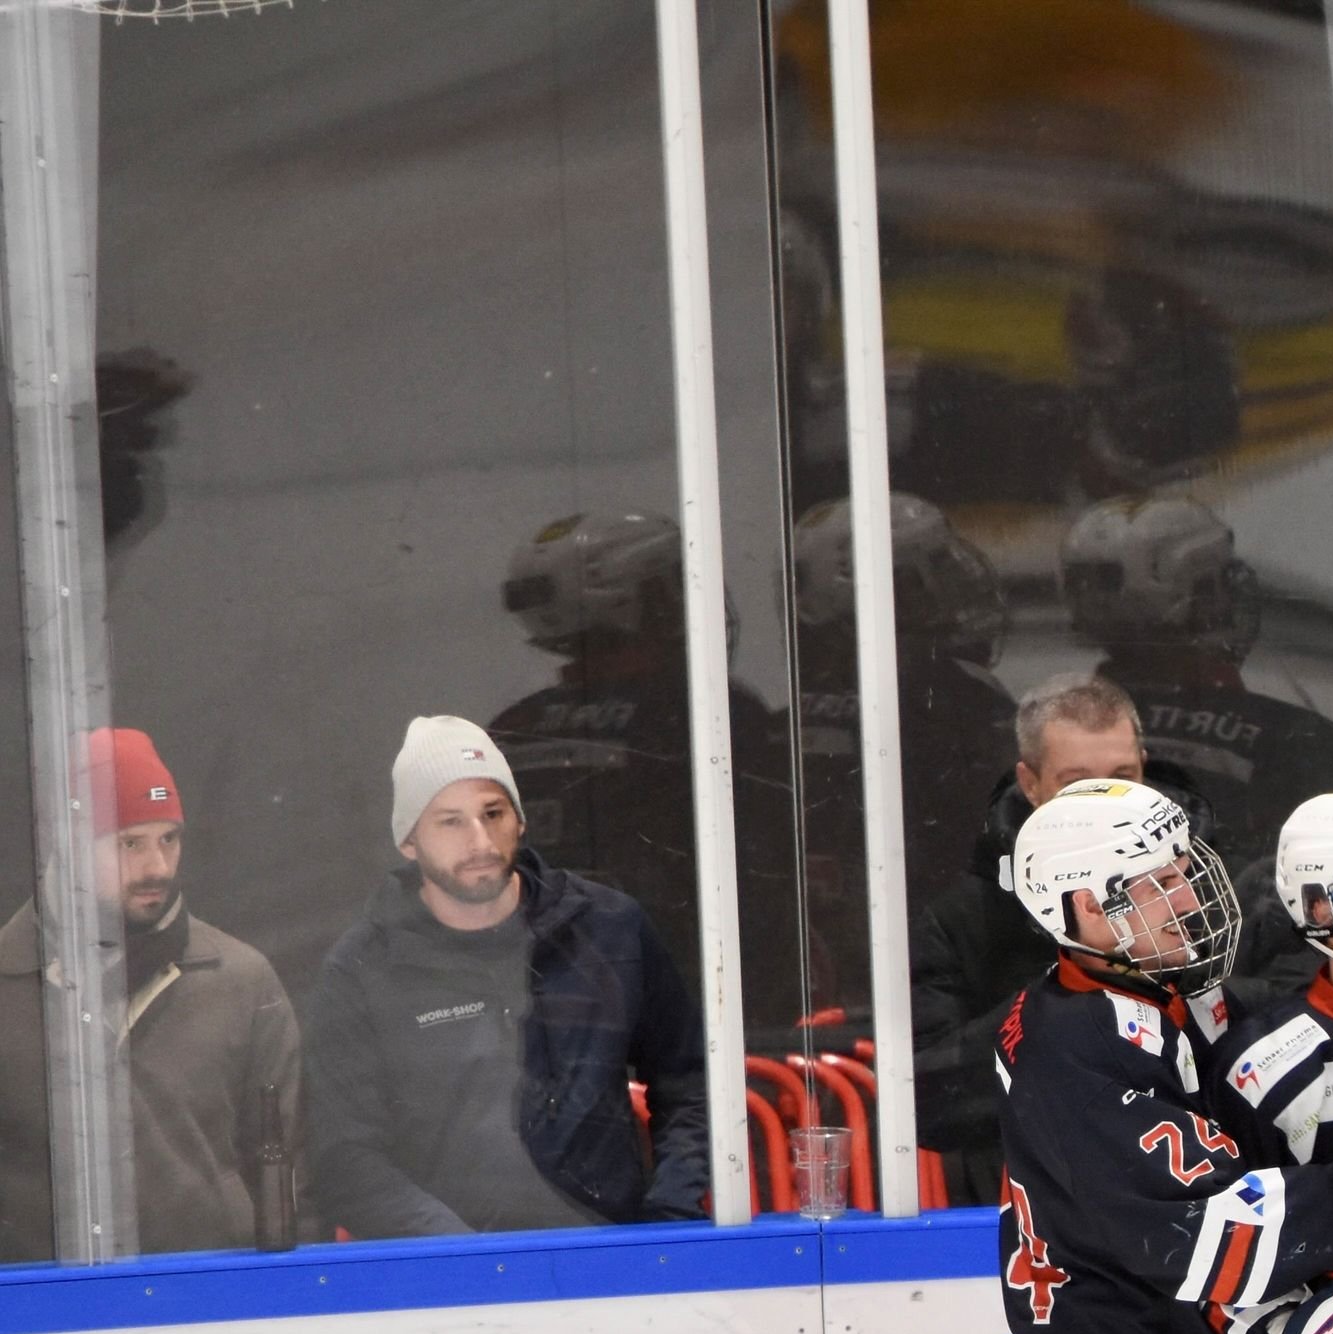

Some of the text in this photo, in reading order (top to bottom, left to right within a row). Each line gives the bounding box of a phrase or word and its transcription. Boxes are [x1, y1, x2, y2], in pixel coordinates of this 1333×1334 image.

[1296, 863, 1325, 873] CCM
[1055, 870, 1092, 882] CCM
[1035, 883, 1049, 895] 24
[1139, 1110, 1240, 1188] 24
